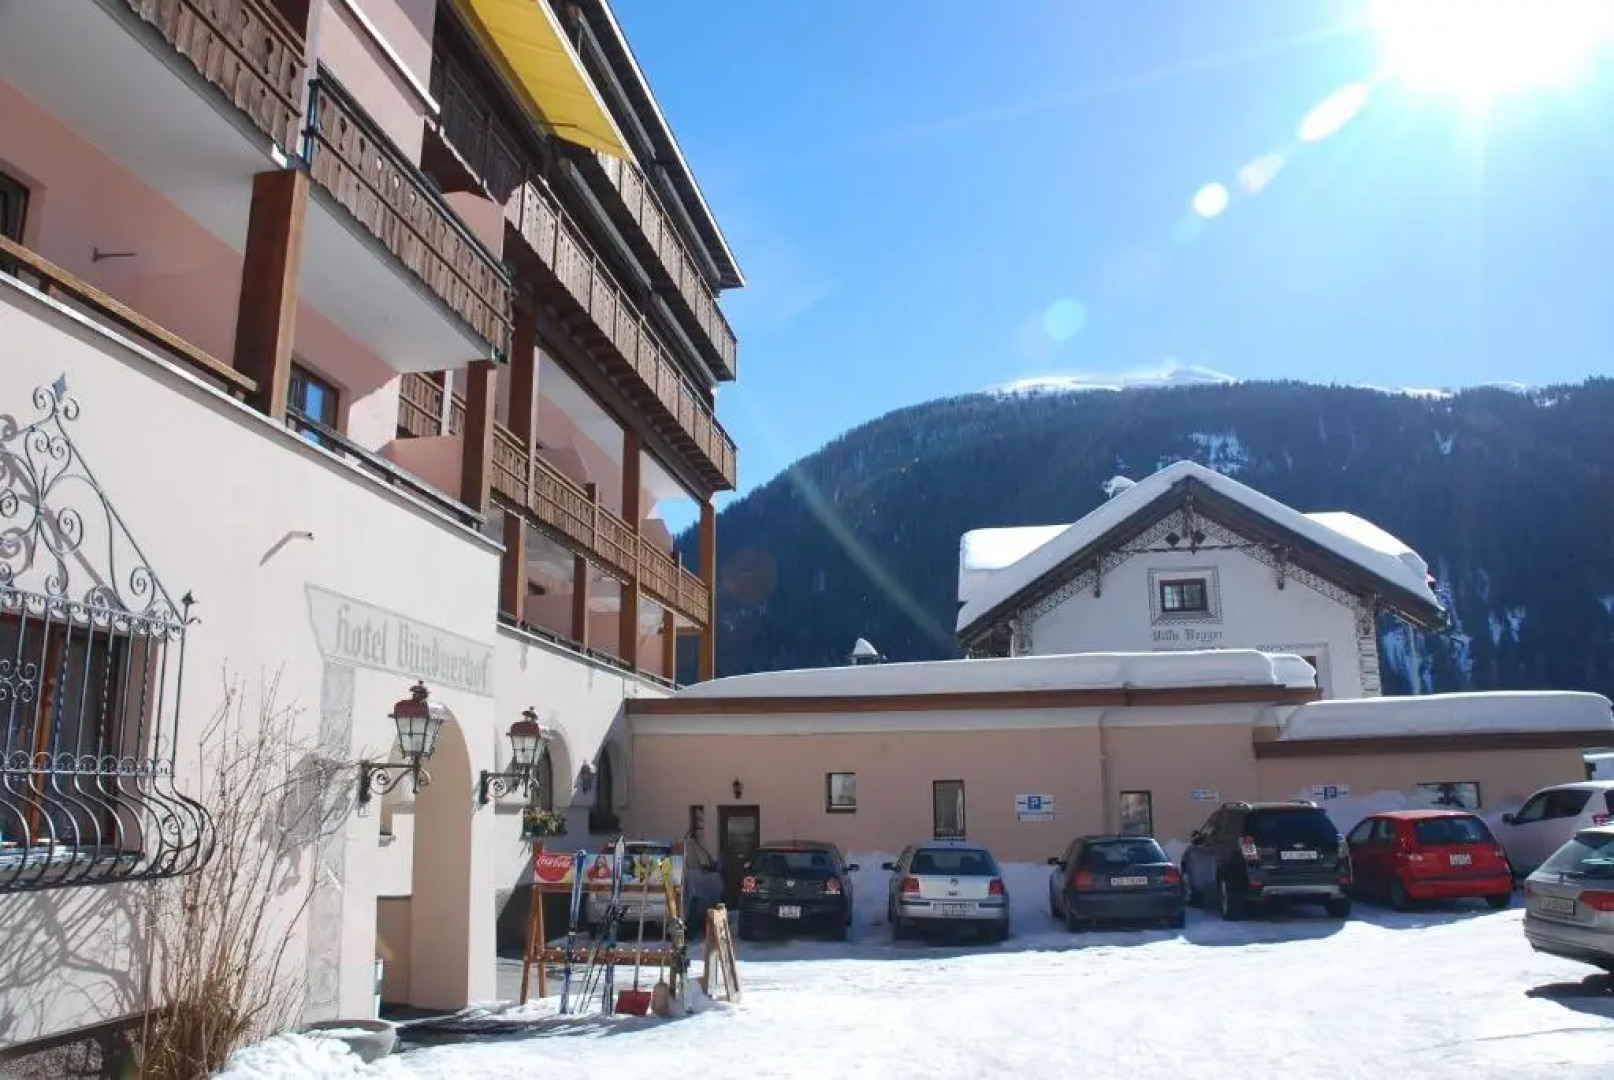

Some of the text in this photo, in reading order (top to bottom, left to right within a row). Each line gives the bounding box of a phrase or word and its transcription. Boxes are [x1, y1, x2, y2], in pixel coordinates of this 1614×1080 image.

[332, 603, 388, 664] Hotel
[1030, 797, 1040, 809] P
[536, 855, 573, 868] Coca-Cola
